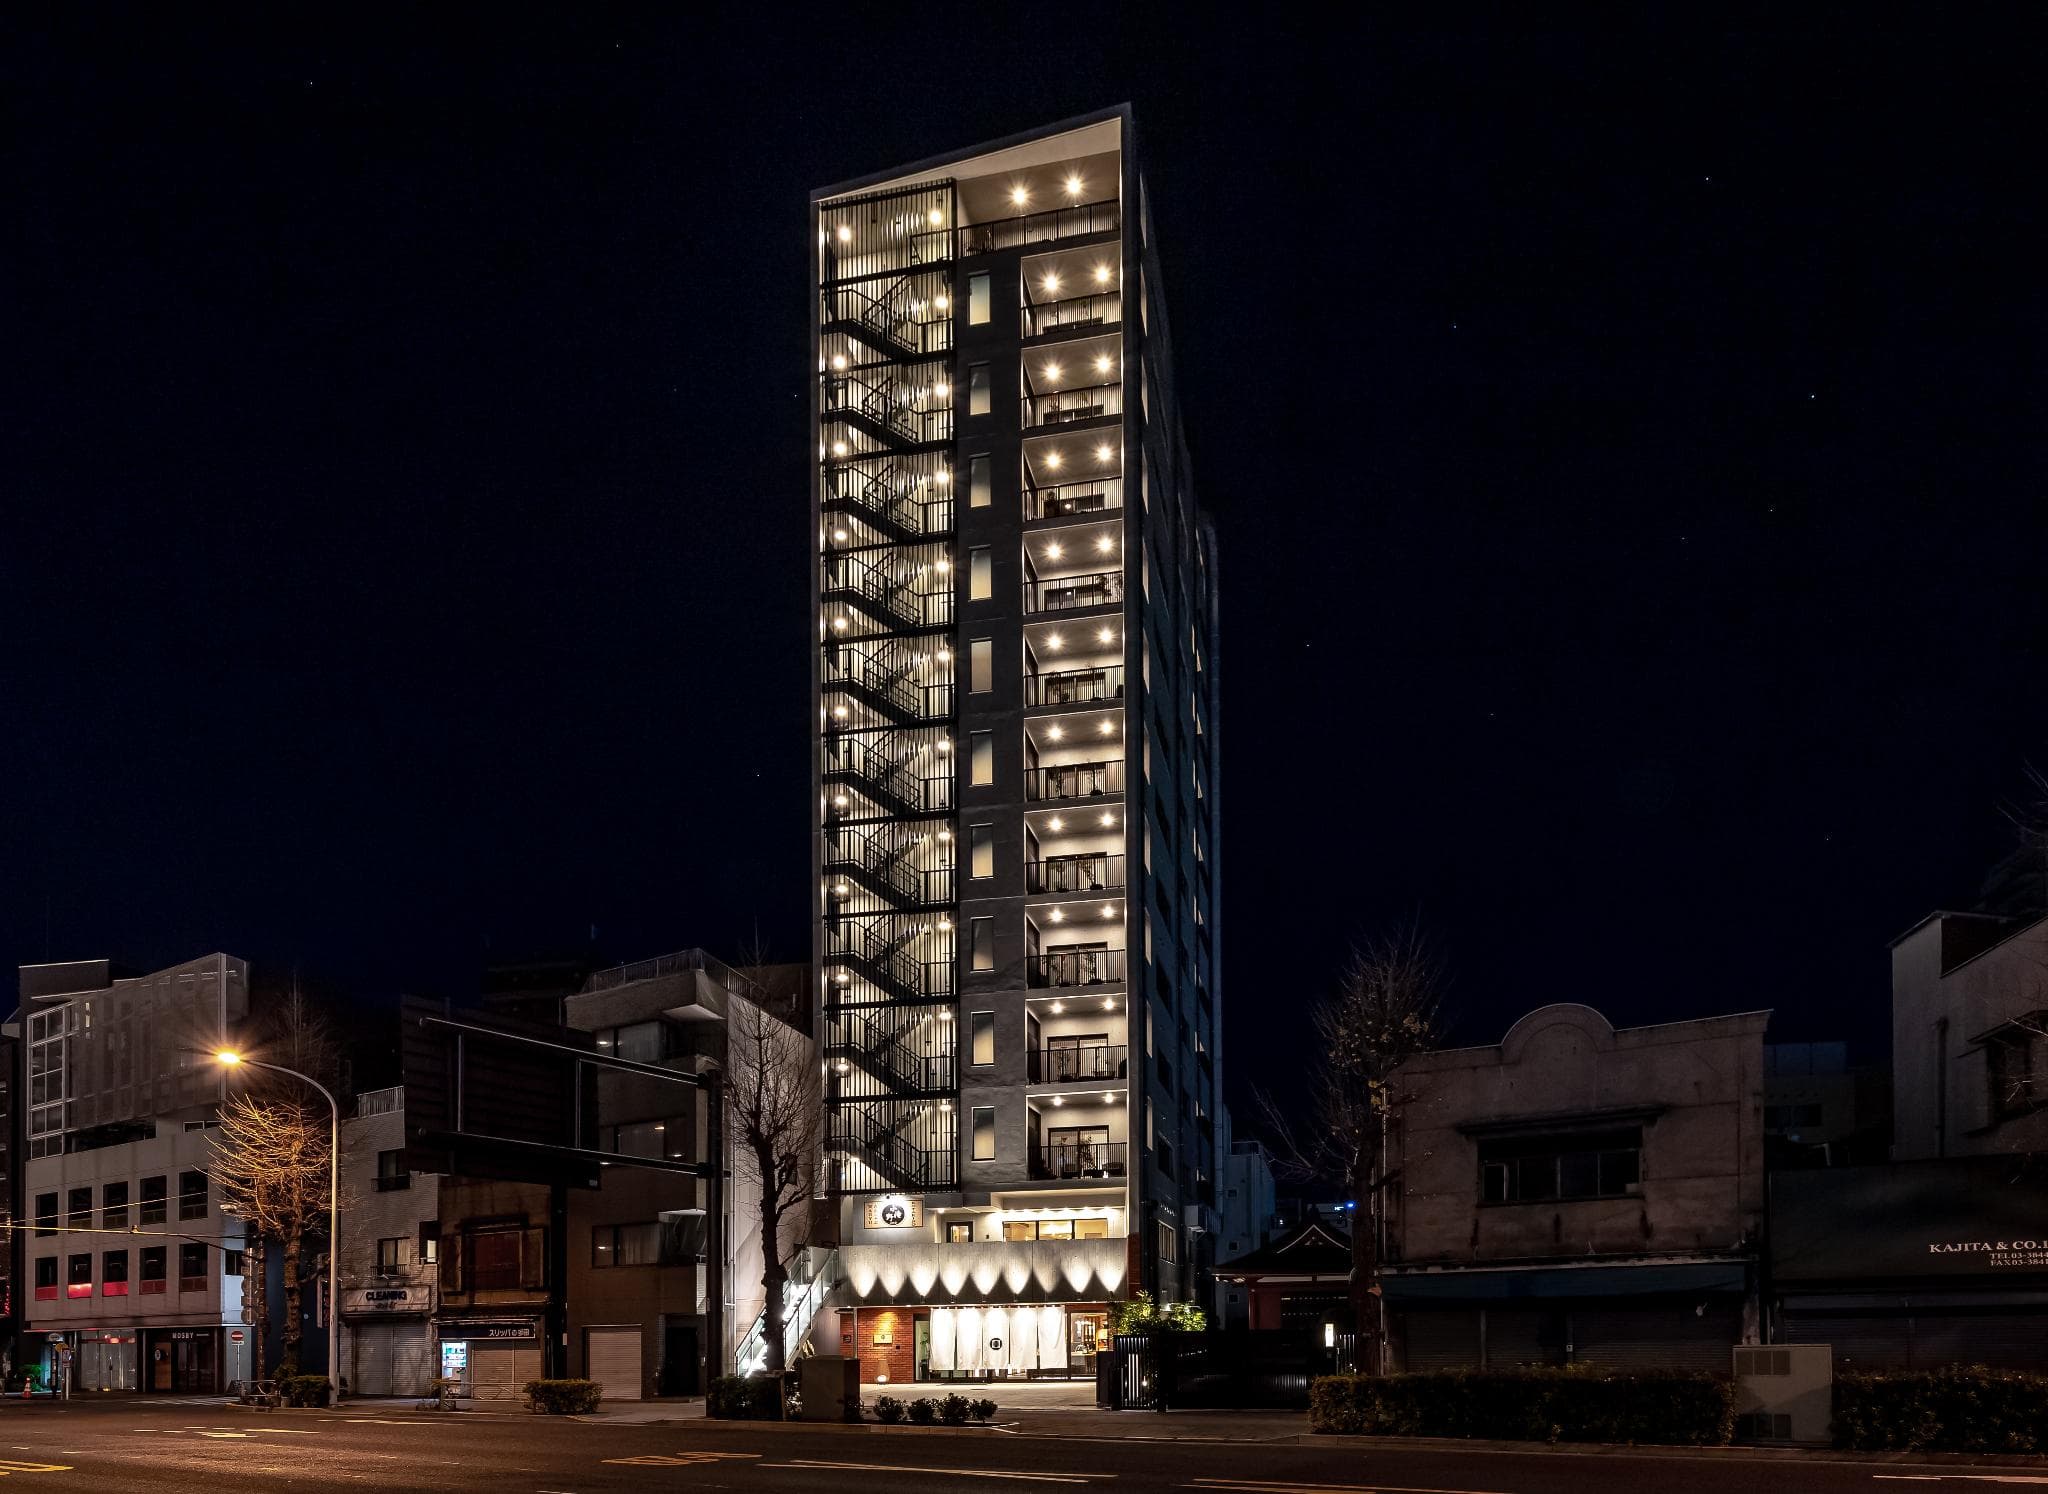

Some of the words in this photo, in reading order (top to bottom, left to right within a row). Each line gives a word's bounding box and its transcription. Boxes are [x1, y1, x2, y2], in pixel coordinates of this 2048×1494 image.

[1928, 1243, 1993, 1253] KAJITA
[1996, 1241, 2009, 1250] &
[365, 1290, 407, 1301] CLEANING
